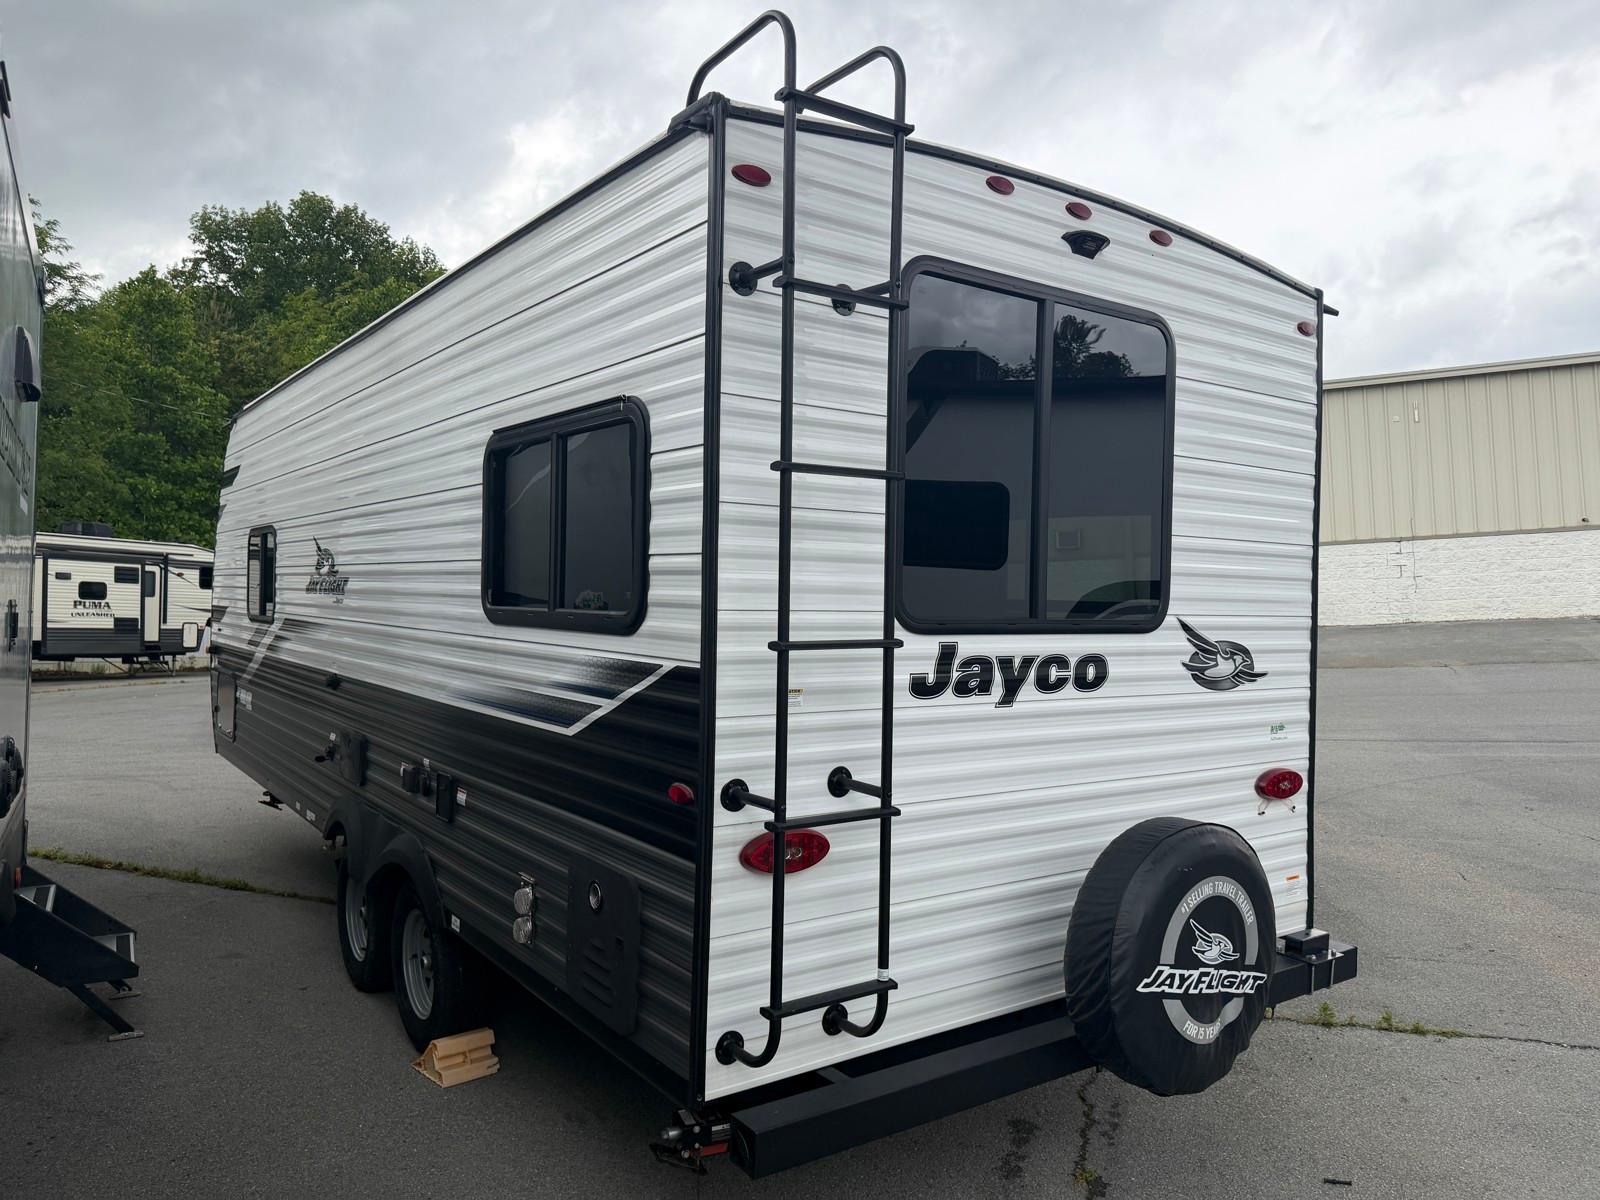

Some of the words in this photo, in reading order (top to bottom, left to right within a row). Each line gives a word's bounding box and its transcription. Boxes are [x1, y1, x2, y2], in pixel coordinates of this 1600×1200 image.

[73, 600, 111, 609] PUMA
[908, 641, 1110, 709] Jayco
[1187, 882, 1214, 908] SELLING
[1215, 881, 1237, 899] TRAVEL
[1236, 890, 1254, 925] TRAILER
[1183, 1020, 1199, 1038] FOR
[1198, 1027, 1205, 1039] 15
